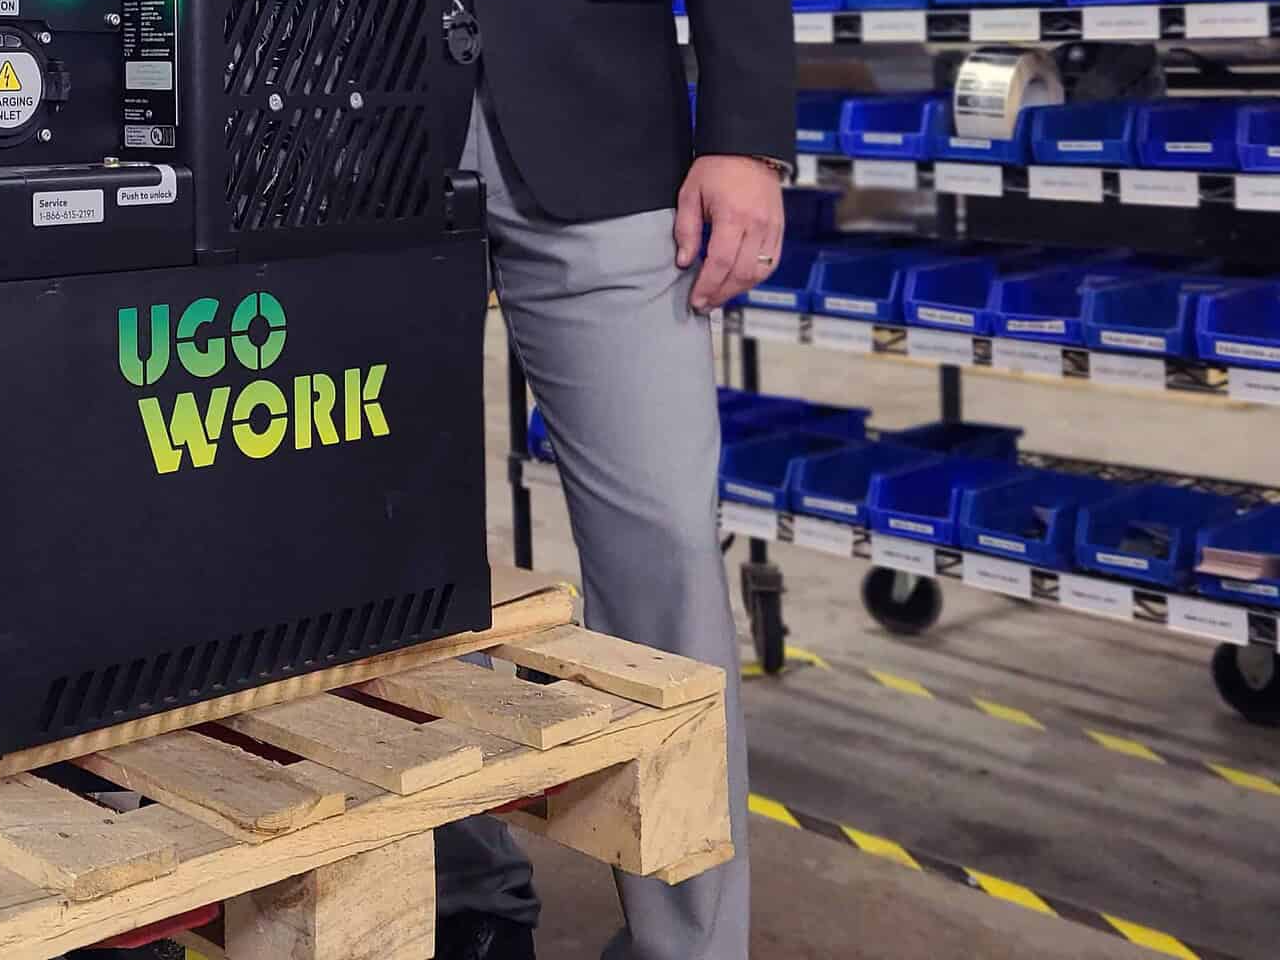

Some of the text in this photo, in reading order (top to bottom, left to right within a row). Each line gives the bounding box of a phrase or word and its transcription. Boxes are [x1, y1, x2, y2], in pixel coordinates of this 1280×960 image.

[0, 1, 15, 11] ON
[121, 192, 138, 201] Push
[149, 189, 172, 199] unlock
[39, 198, 67, 208] Service
[39, 209, 95, 221] 1-866-615-2191
[118, 292, 287, 386] UGO
[138, 363, 391, 474] WORK
